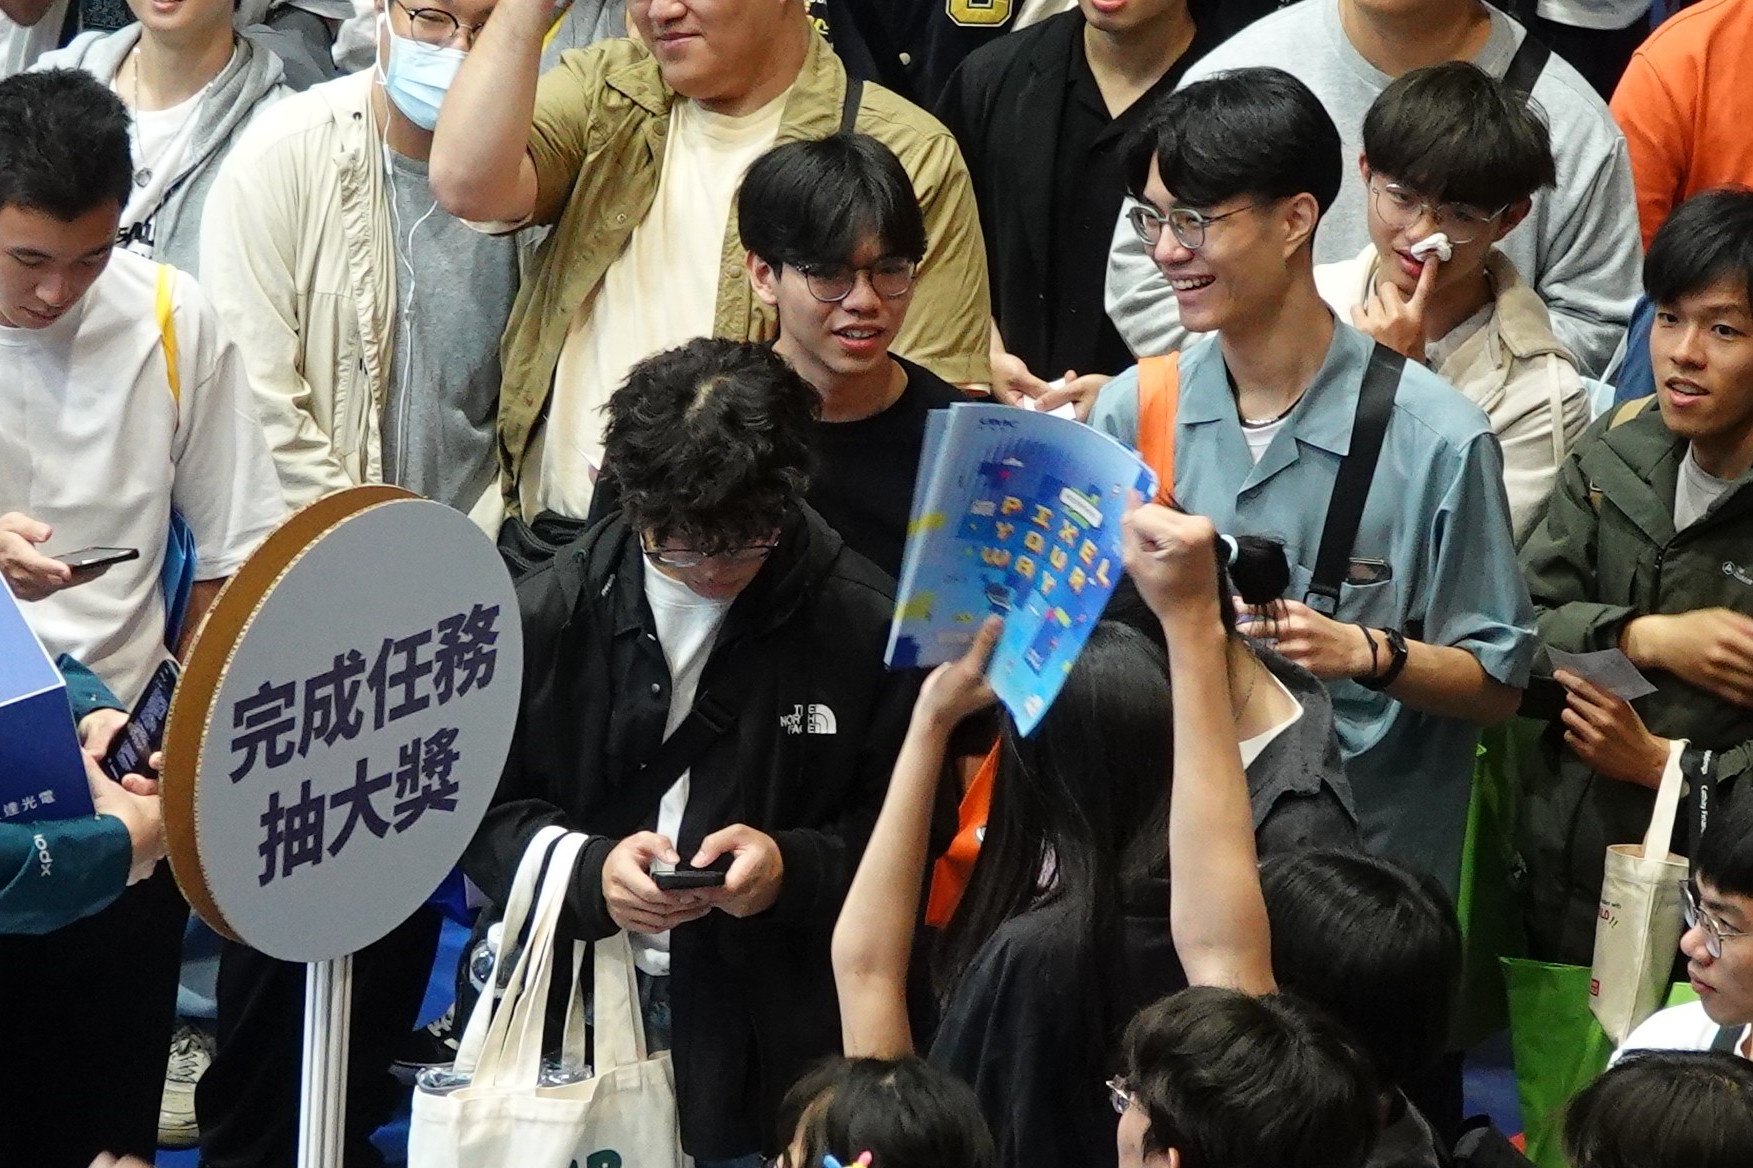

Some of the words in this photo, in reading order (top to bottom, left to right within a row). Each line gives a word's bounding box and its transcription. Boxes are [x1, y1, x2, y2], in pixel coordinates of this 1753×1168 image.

[228, 603, 500, 784] 完成任務
[258, 727, 460, 887] 抽大獎
